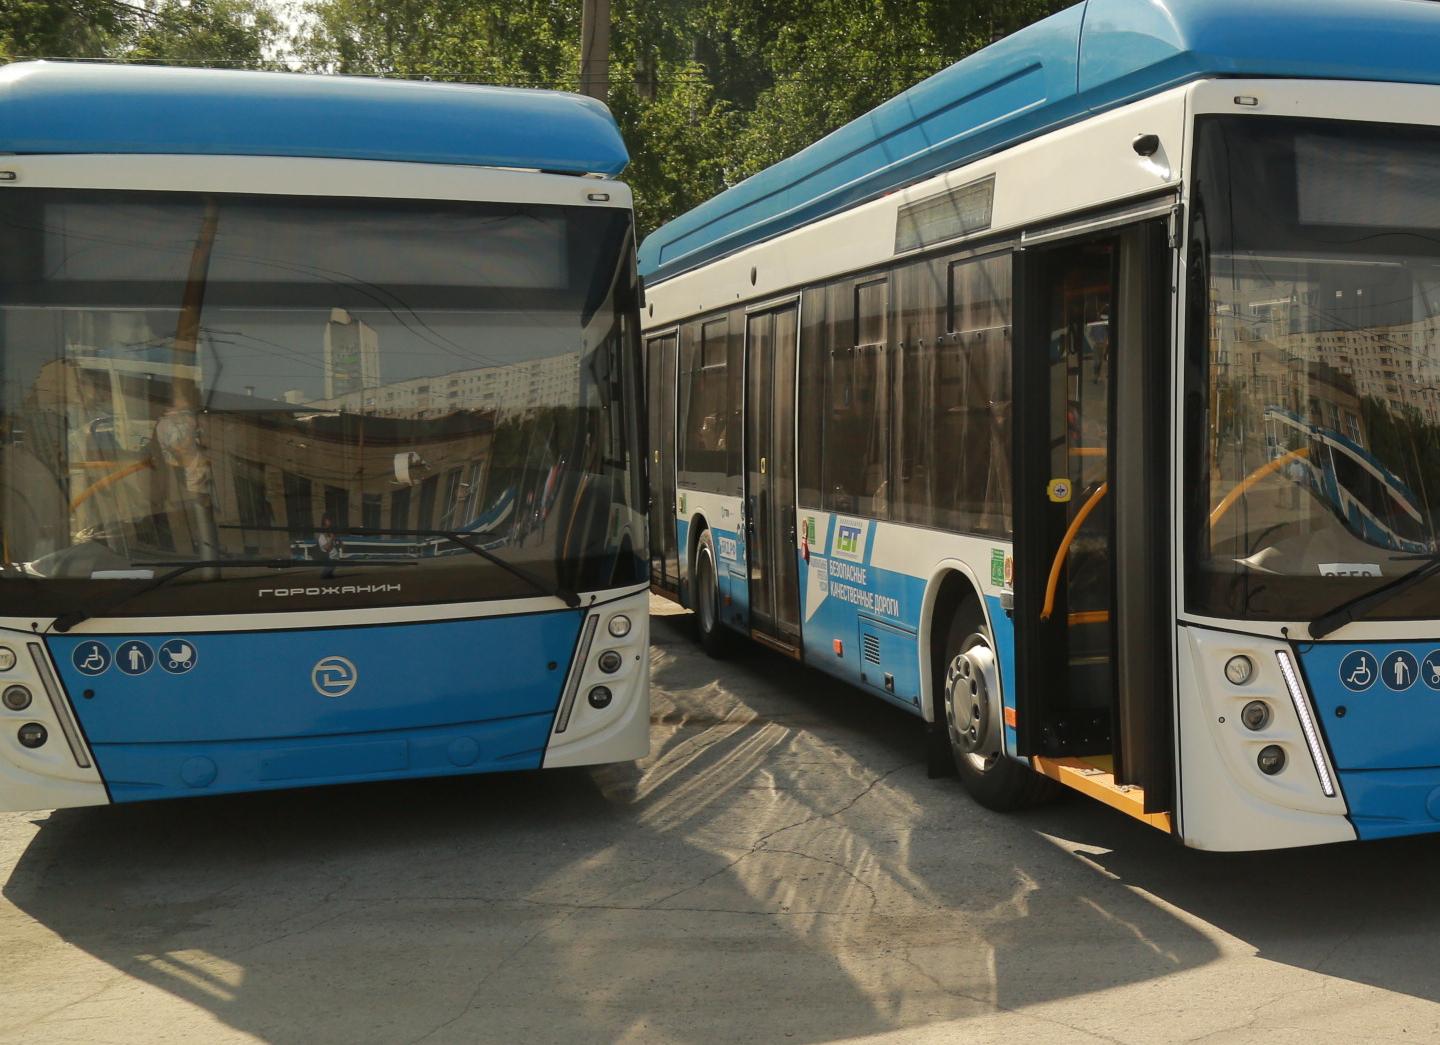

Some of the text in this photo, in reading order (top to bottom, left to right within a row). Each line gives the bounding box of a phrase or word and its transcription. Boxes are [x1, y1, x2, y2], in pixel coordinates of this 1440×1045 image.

[829, 559, 867, 586] БЕЗОПАСНЫЕ
[258, 583, 401, 598] ГОРОЖАНИН
[830, 580, 899, 617] КАЧЕСТВЕННЫЕ ДОРОГИ
